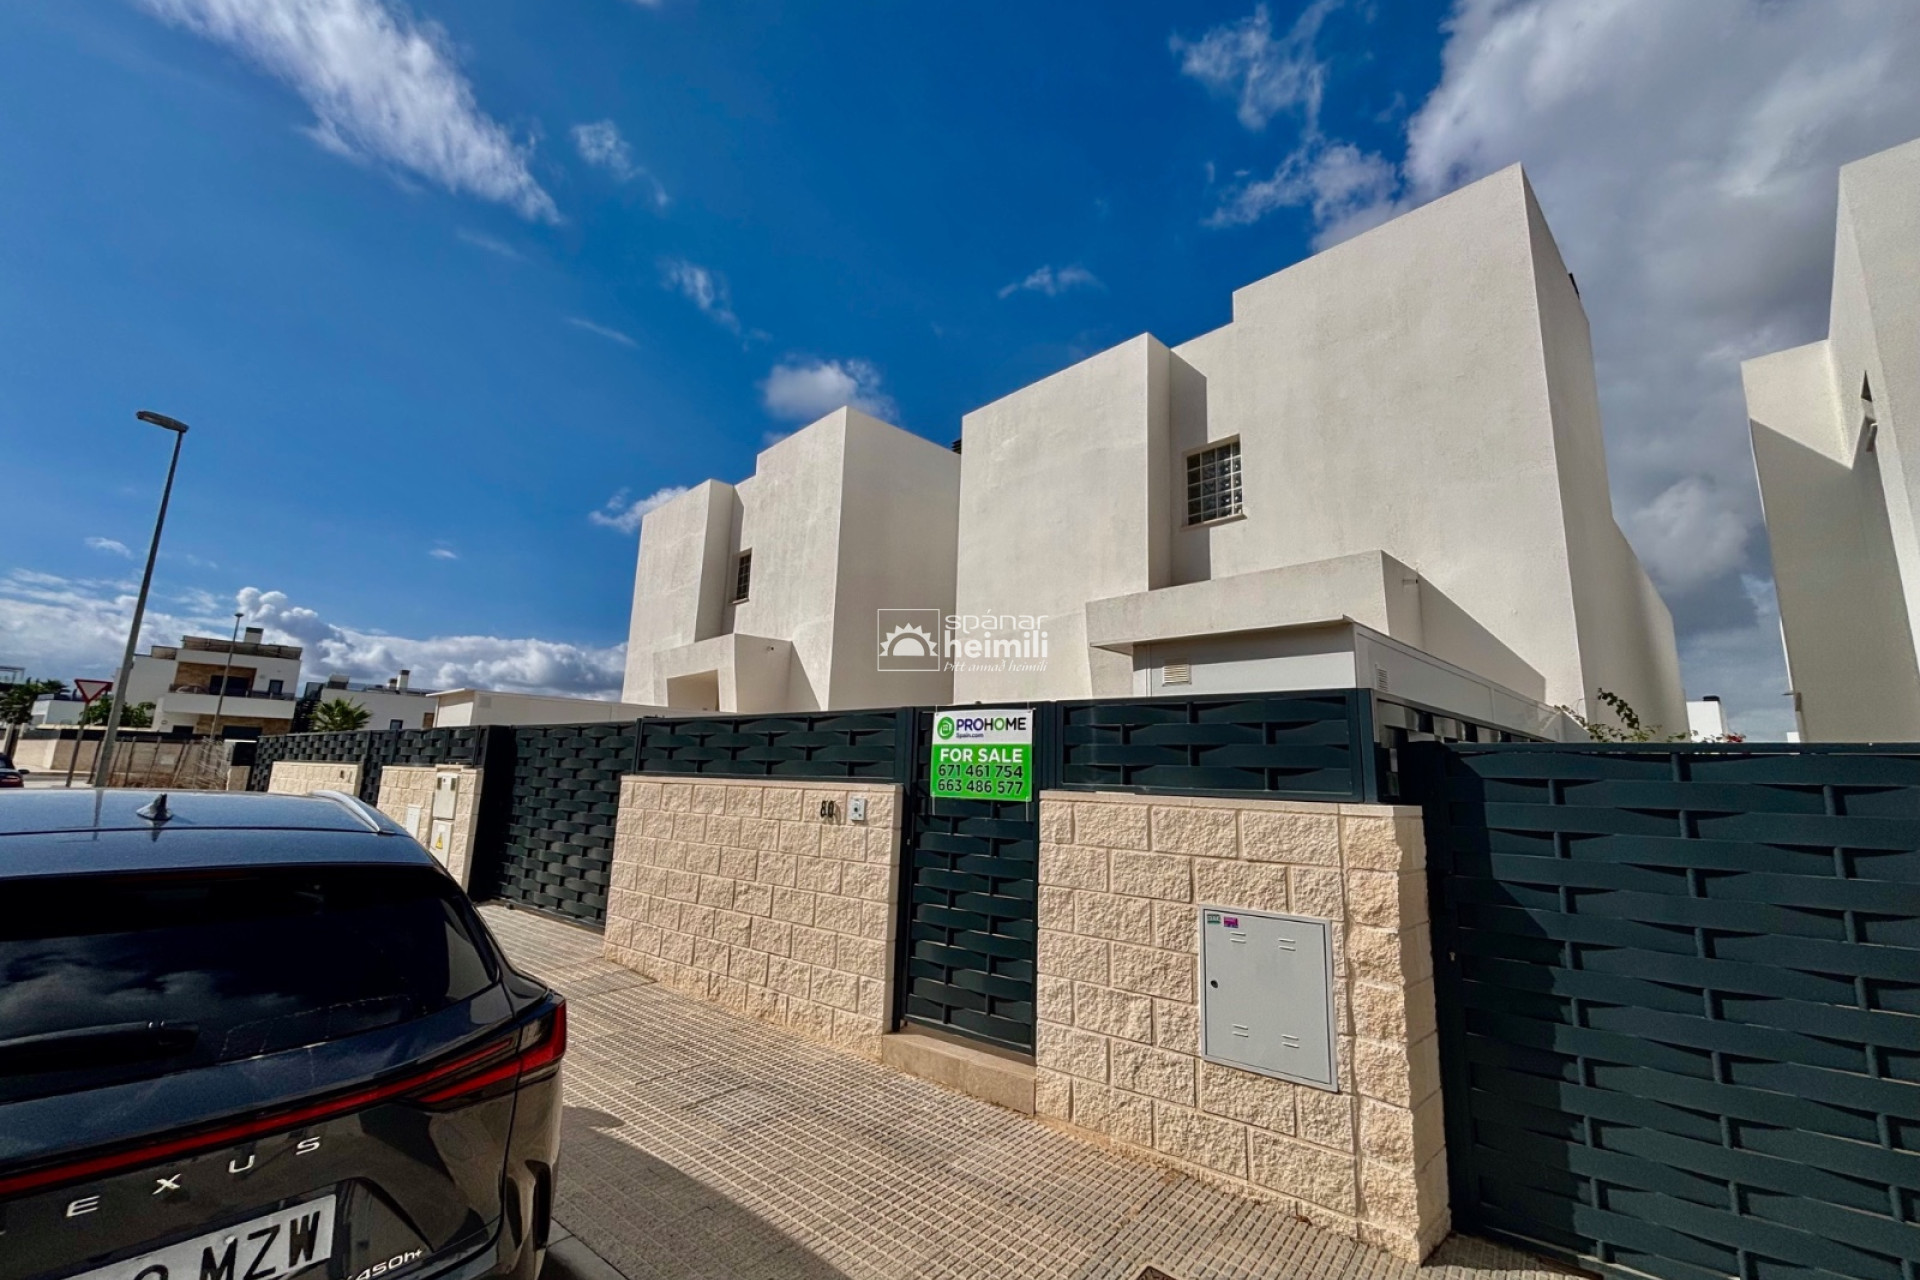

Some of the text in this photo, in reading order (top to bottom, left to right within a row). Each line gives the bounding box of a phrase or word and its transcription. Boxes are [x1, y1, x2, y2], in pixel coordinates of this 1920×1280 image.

[956, 717, 1027, 731] PROHOME
[940, 748, 1023, 763] FOR SALE
[938, 764, 1023, 778] 671 461 754
[938, 779, 1023, 794] 663 486 577
[0, 1136, 320, 1236] EXUS
[200, 1210, 321, 1280] MZW
